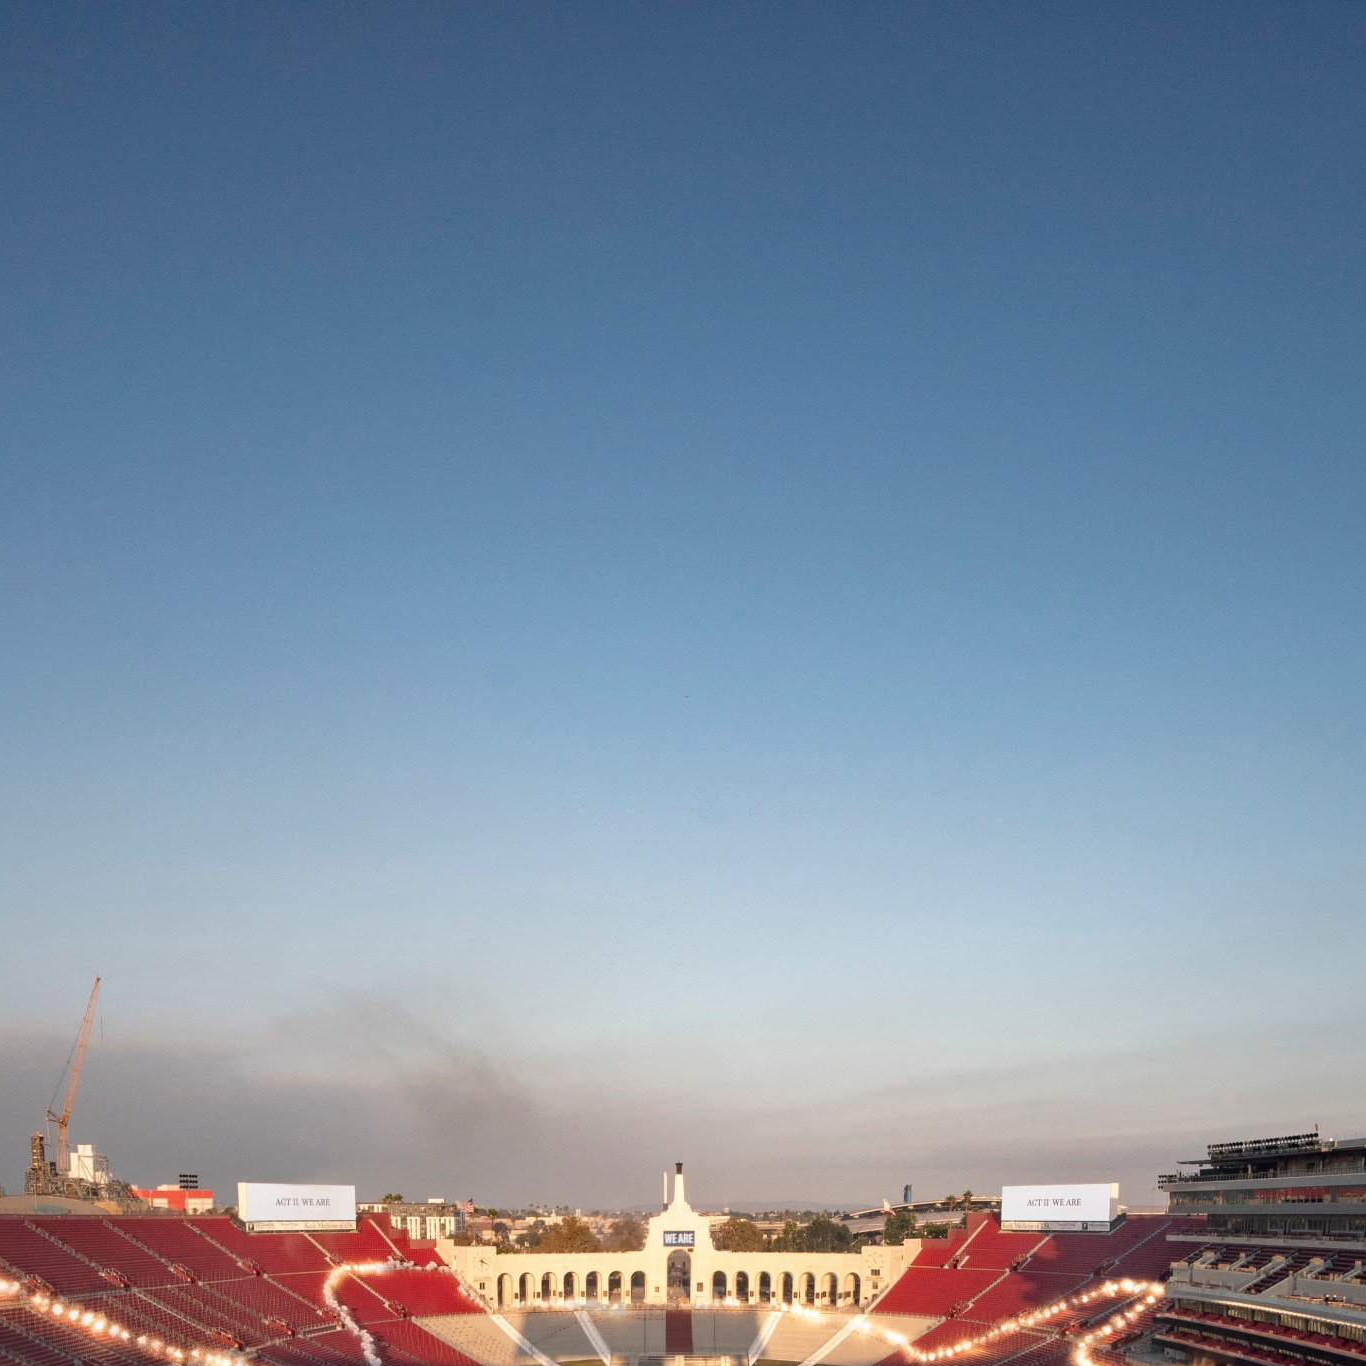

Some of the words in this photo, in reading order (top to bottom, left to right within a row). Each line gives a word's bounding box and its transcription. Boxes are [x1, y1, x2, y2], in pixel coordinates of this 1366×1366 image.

[275, 1198, 292, 1206] ACT
[302, 1198, 315, 1206] WE
[315, 1198, 331, 1206] ARE
[1026, 1199, 1043, 1207] ACT
[1052, 1199, 1065, 1207] WE
[1065, 1198, 1082, 1206] ARE
[665, 1233, 677, 1244] WE
[678, 1233, 694, 1244] ARE
